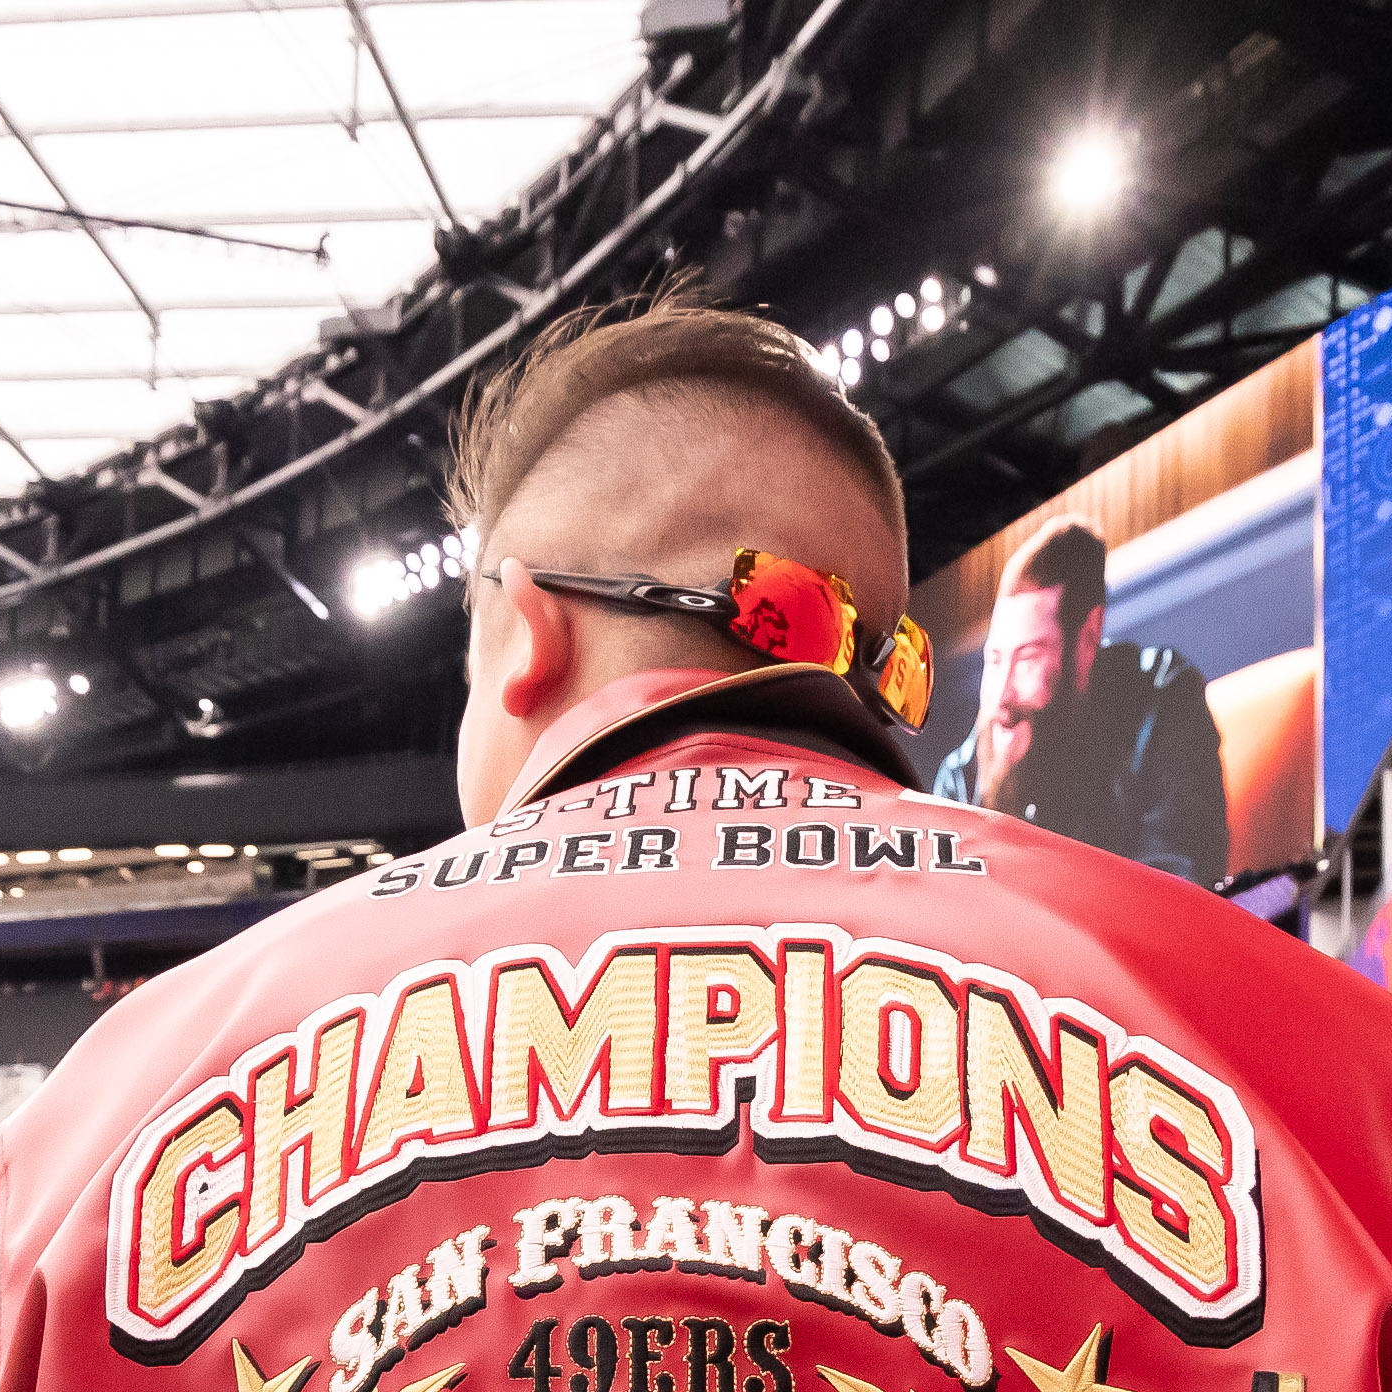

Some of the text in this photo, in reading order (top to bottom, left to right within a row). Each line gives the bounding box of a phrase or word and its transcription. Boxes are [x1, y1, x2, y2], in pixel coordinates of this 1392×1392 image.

[365, 821, 989, 901] SUPER BOWL
[108, 923, 1262, 1350] CHAMPIONS
